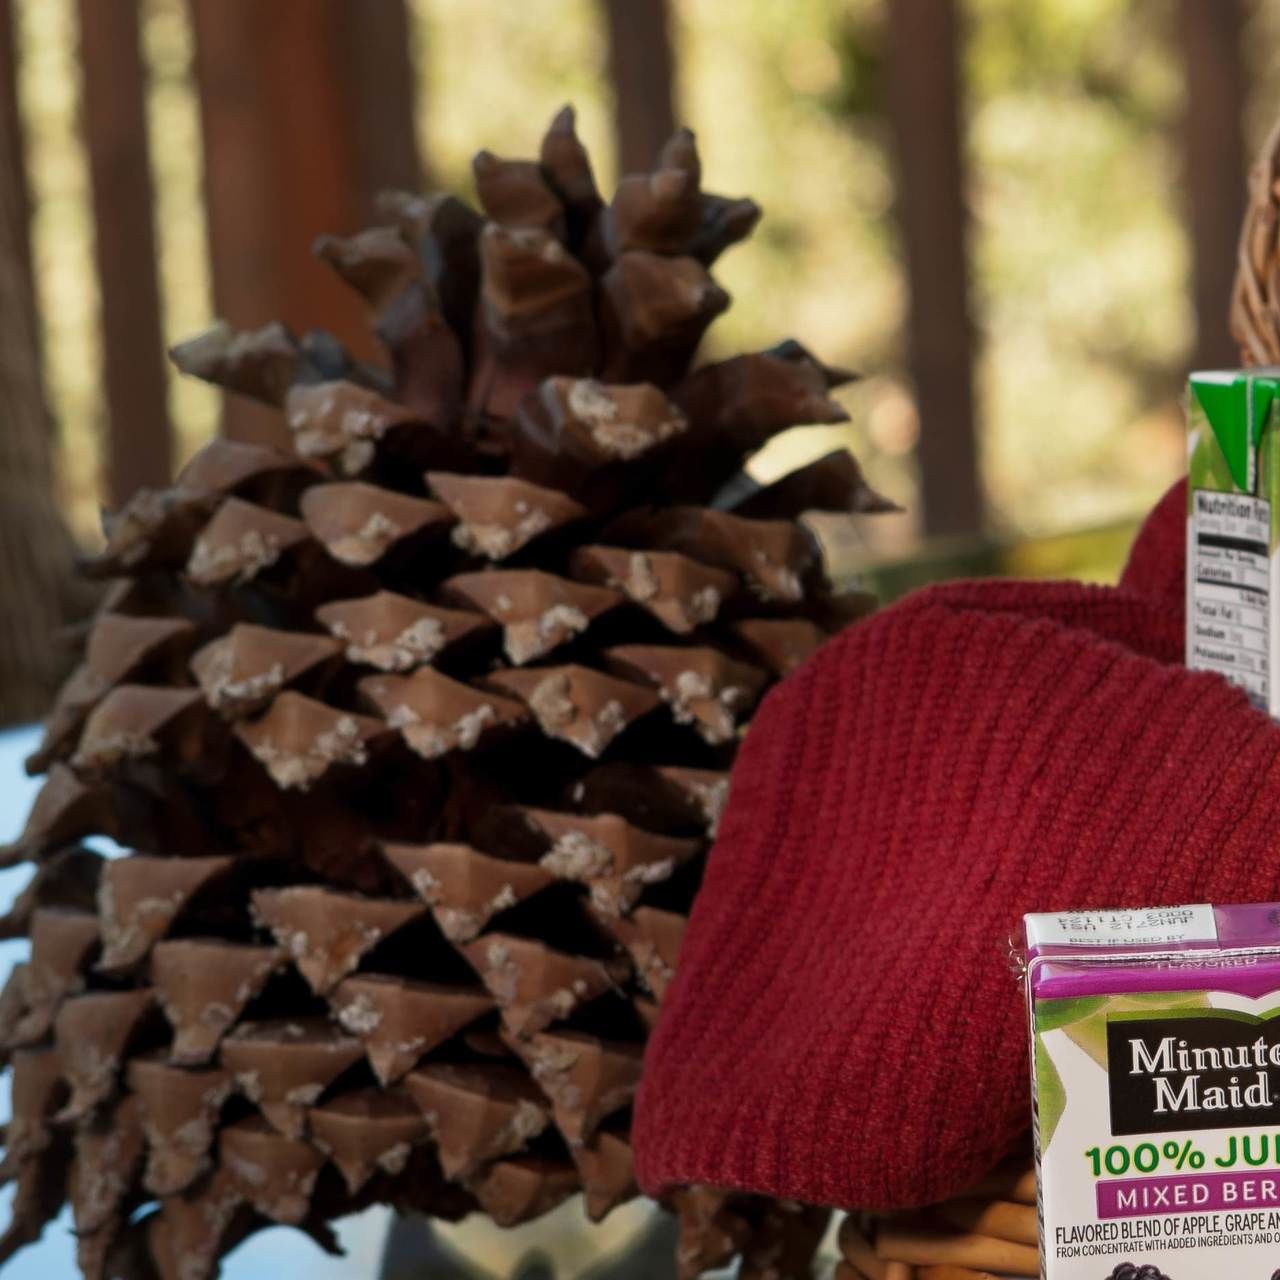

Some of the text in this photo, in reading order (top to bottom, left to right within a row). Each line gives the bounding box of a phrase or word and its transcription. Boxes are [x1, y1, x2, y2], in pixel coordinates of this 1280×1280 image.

[1152, 1072, 1273, 1112] Maid
[1085, 1140, 1205, 1176] 100%
[1117, 1183, 1210, 1210] MIXED
[1056, 1222, 1118, 1245] FLAVORED
[1122, 1220, 1161, 1240] BLEND
[1163, 1217, 1180, 1236] OF
[1182, 1214, 1223, 1235] APPLE,
[1225, 1212, 1266, 1231] GRAPE
[1056, 1246, 1081, 1259] FROM
[1082, 1241, 1144, 1257] CONCENTRATE
[1144, 1238, 1167, 1252] WITH
[1168, 1237, 1196, 1250] ADDED
[1197, 1232, 1253, 1248] INGREDIENTS
[1254, 1232, 1273, 1245] AND
